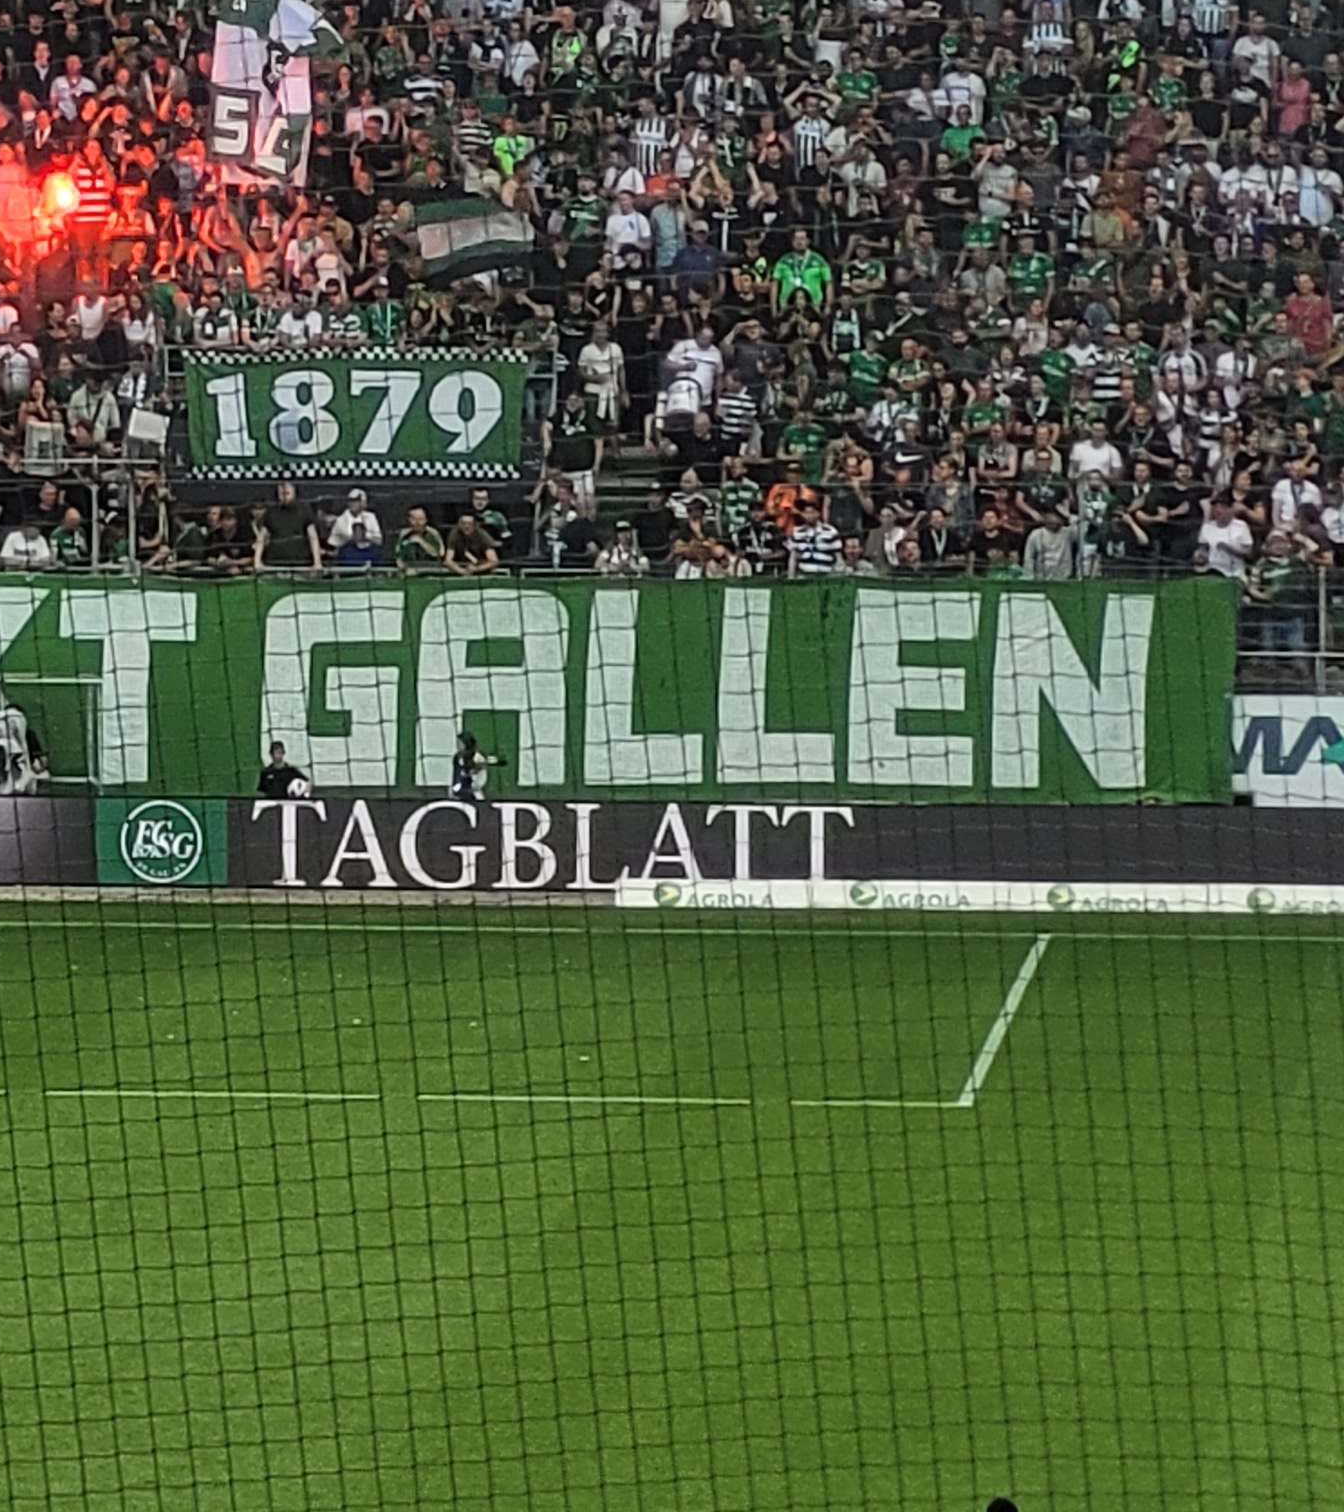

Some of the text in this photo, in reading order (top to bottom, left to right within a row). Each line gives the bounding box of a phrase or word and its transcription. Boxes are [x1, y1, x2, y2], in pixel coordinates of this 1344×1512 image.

[205, 369, 503, 456] 1879
[261, 586, 1155, 790] GALLEN
[251, 799, 856, 892] TAGBLATT
[686, 892, 774, 908] AGROLA
[882, 893, 972, 908] AGROLA
[1079, 897, 1171, 913] AGROLA
